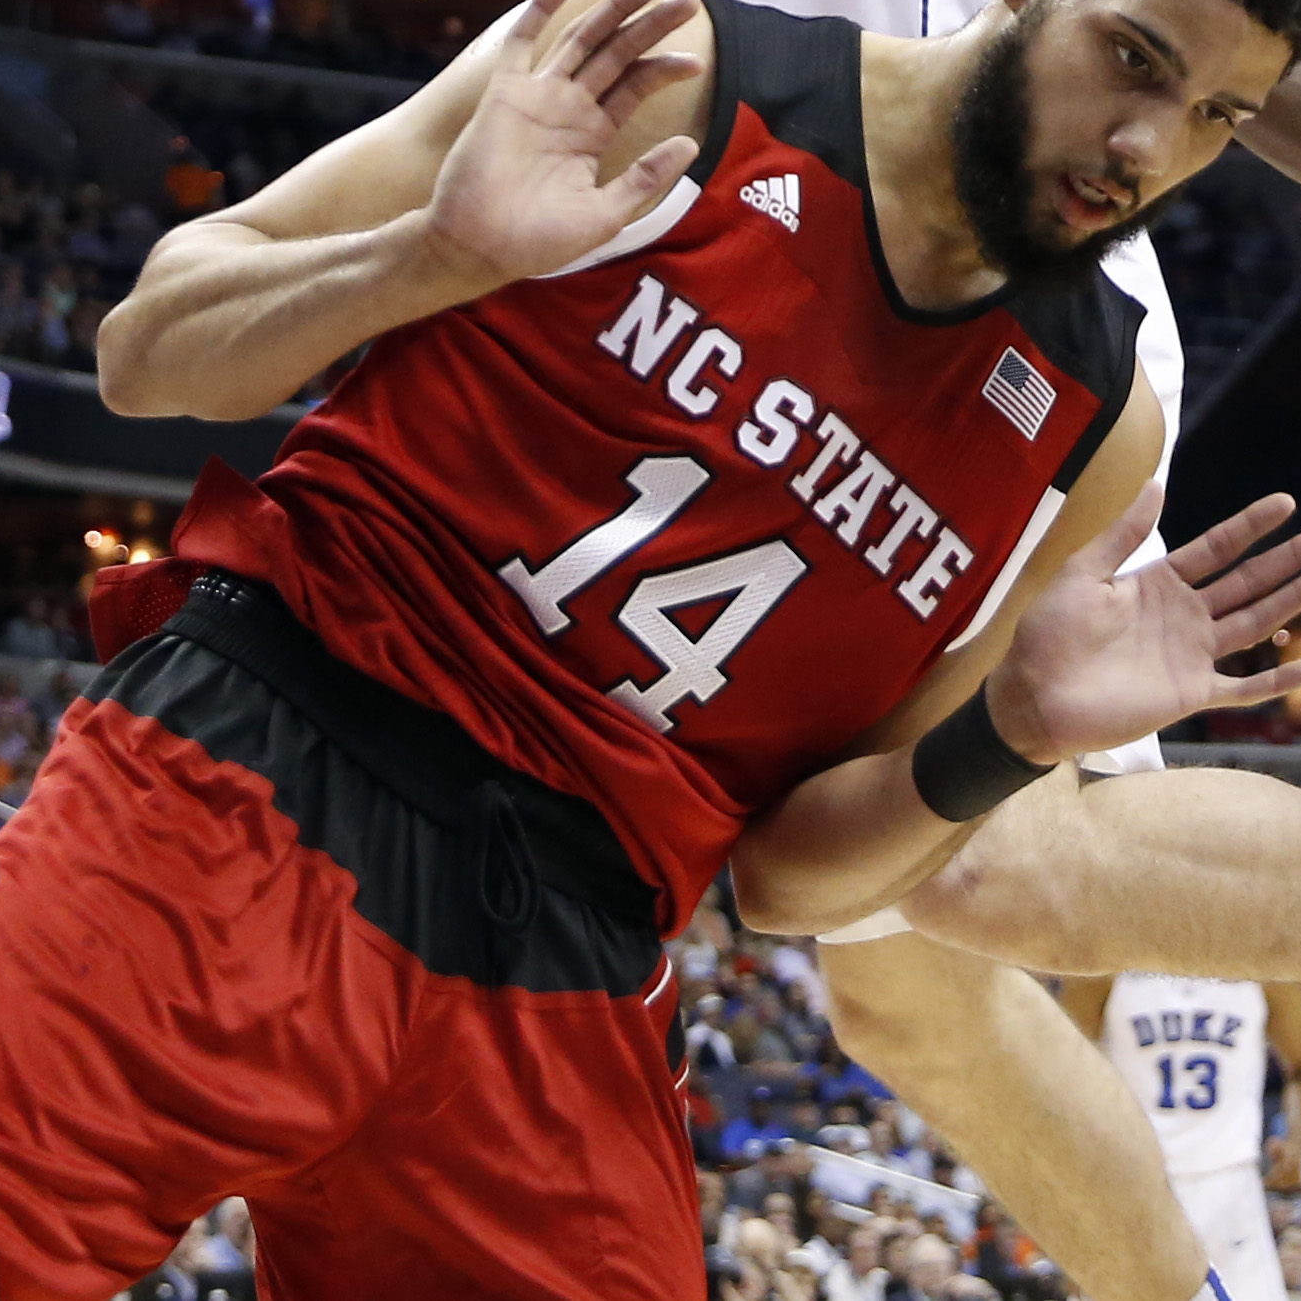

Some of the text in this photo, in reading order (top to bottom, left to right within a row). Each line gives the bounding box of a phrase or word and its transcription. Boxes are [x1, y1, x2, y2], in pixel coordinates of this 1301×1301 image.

[739, 183, 801, 234] adidas
[597, 273, 975, 621] NC STATE
[497, 454, 809, 734] 14
[1130, 1010, 1243, 1048] DUKE
[1156, 1054, 1219, 1111] 13
